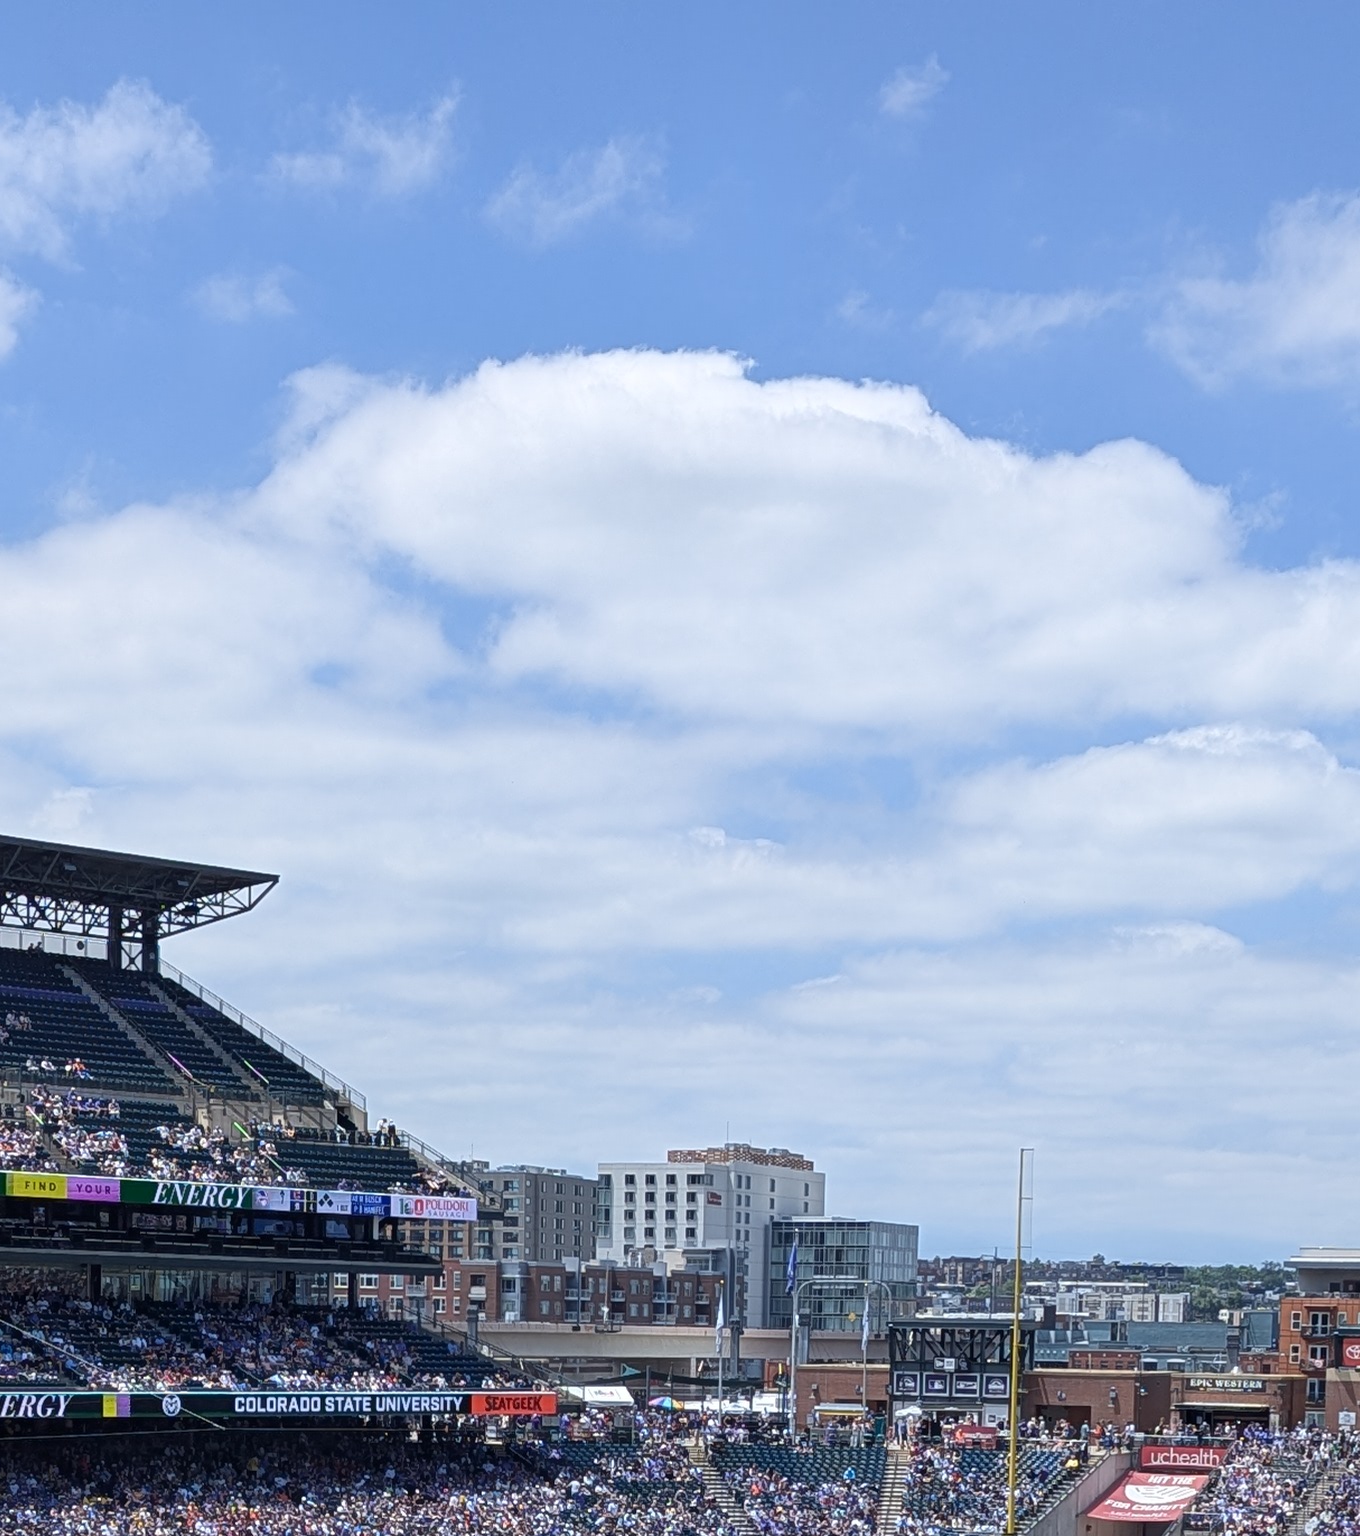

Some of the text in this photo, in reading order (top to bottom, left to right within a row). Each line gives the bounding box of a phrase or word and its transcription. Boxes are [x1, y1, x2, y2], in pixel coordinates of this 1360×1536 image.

[25, 1180, 111, 1195] FIND YOUR
[151, 1181, 251, 1208] ENERGY
[425, 1199, 469, 1212] POLIDORI
[1189, 1378, 1263, 1389] EPIC WESTERN
[234, 1395, 463, 1413] COLORADO STATE UNIVERSITY
[484, 1395, 543, 1412] SEATGEEK
[1150, 1447, 1220, 1465] uchealth
[1147, 1475, 1196, 1485] HIT THE
[1104, 1499, 1187, 1511] FOR CHARITY
